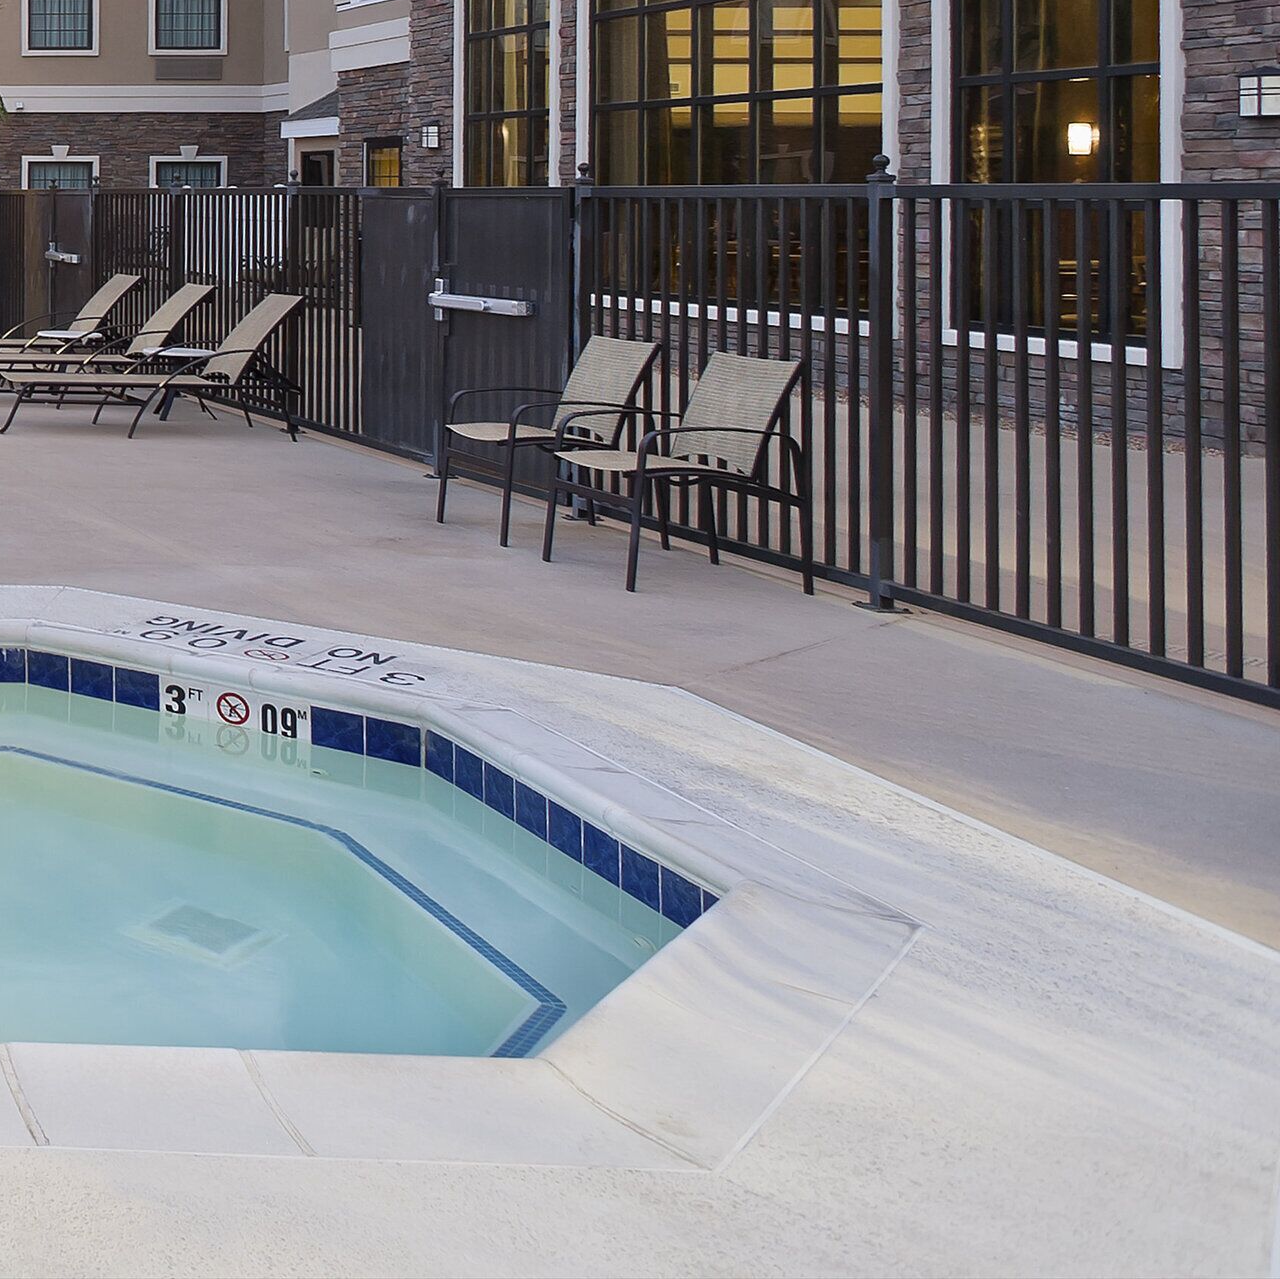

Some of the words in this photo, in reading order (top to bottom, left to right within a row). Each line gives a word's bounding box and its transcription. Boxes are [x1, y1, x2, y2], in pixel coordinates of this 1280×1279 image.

[145, 614, 307, 649] DIVING
[327, 646, 398, 666] NO
[296, 658, 371, 676] FT
[379, 671, 427, 687] 3
[165, 684, 187, 715] 3
[188, 687, 204, 702] FT
